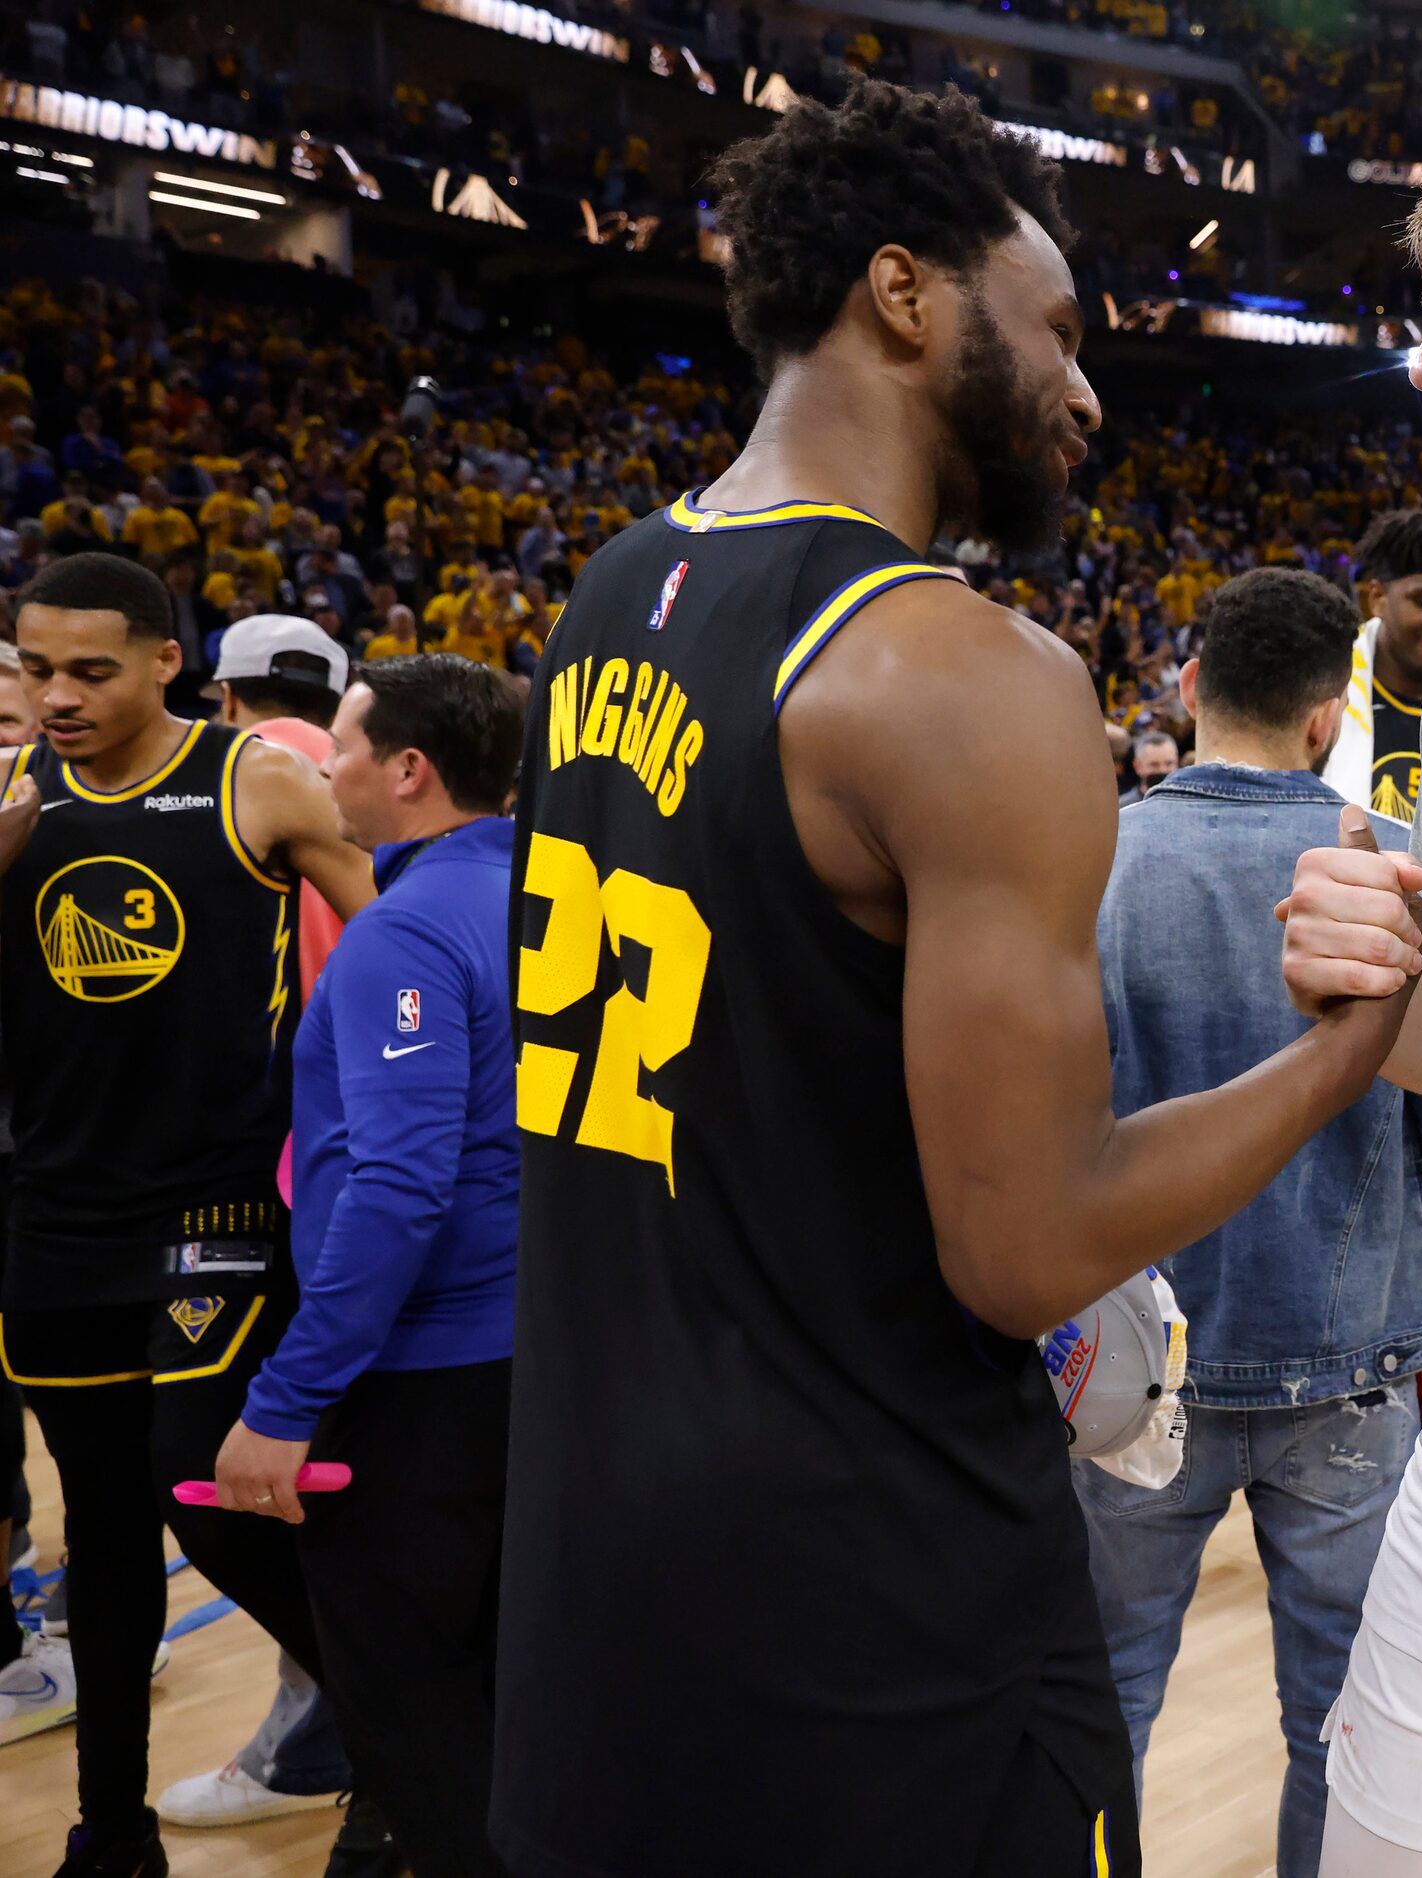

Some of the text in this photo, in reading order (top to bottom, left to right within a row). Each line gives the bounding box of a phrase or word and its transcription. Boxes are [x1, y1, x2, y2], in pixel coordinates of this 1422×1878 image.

[549, 656, 704, 817] WIGGINS
[144, 793, 214, 811] Rakuten
[123, 888, 155, 930] 3
[516, 831, 712, 1200] 22
[1060, 1337, 1091, 1388] 2022
